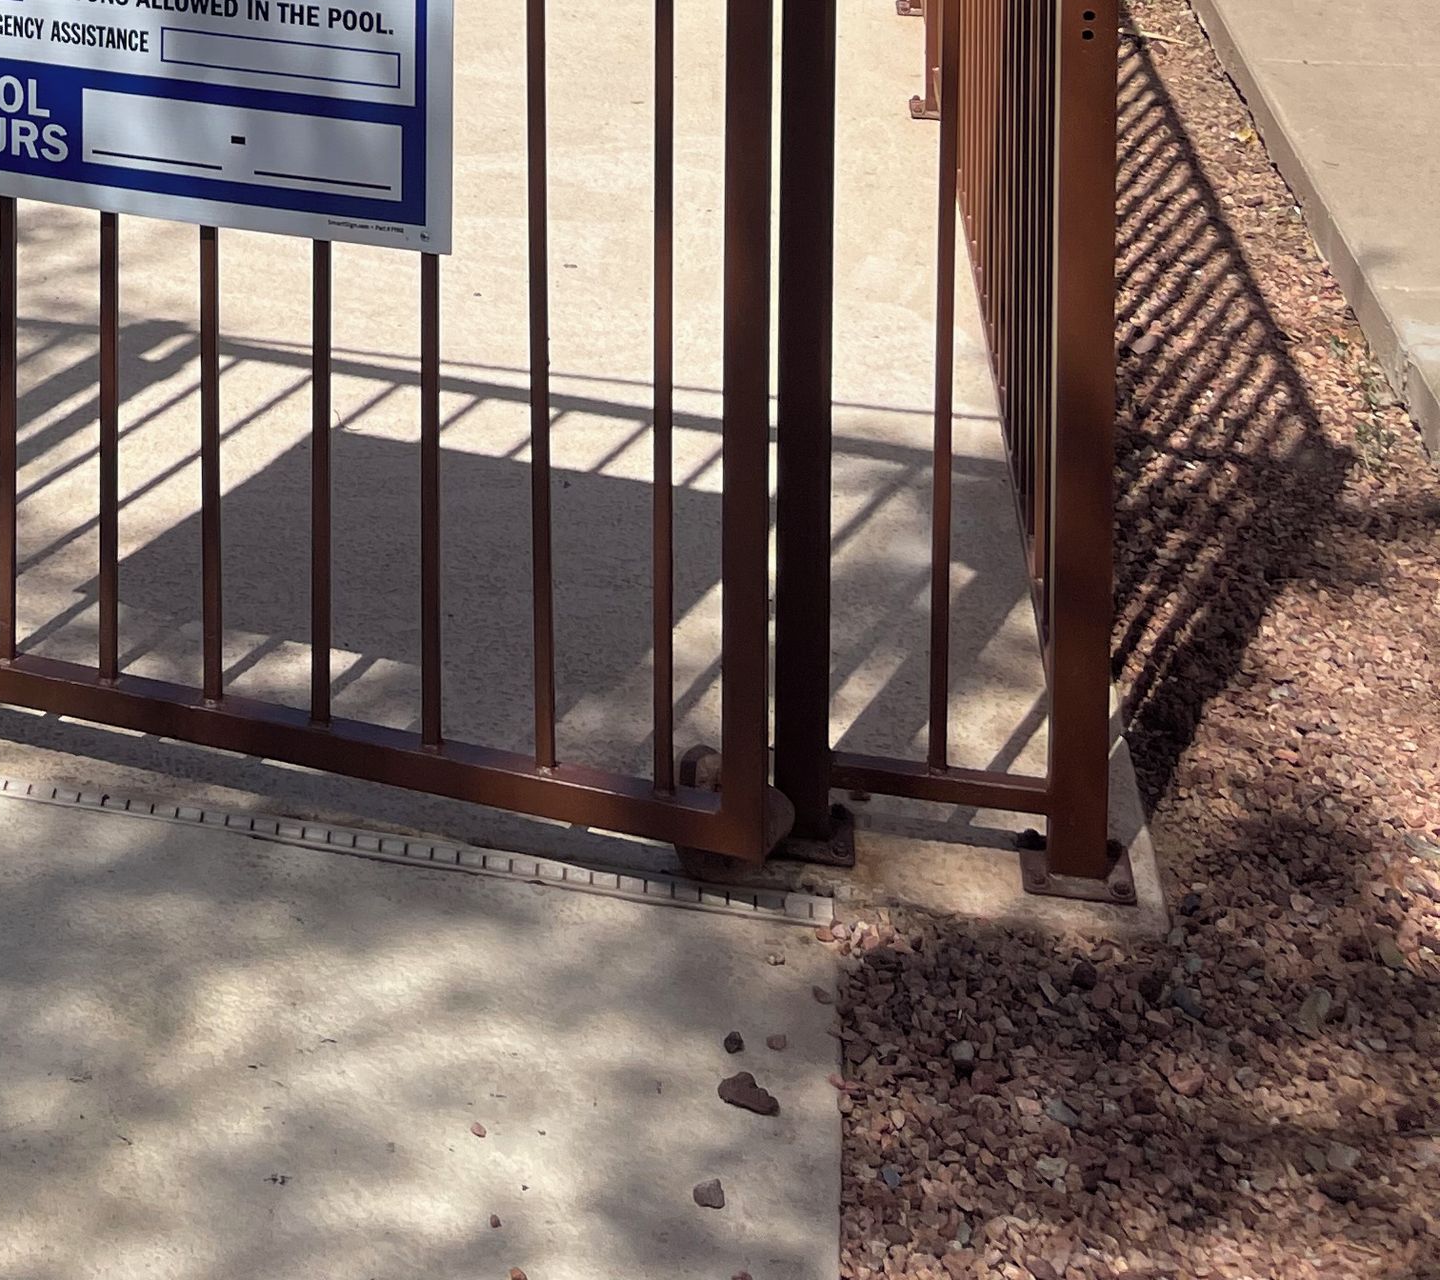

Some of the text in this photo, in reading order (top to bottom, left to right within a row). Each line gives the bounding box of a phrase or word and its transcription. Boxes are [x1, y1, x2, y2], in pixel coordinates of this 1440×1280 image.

[248, 0, 269, 21] IN
[277, 2, 319, 27] THE
[328, 8, 393, 35] POOL.
[51, 21, 149, 52] ASSISTANCE
